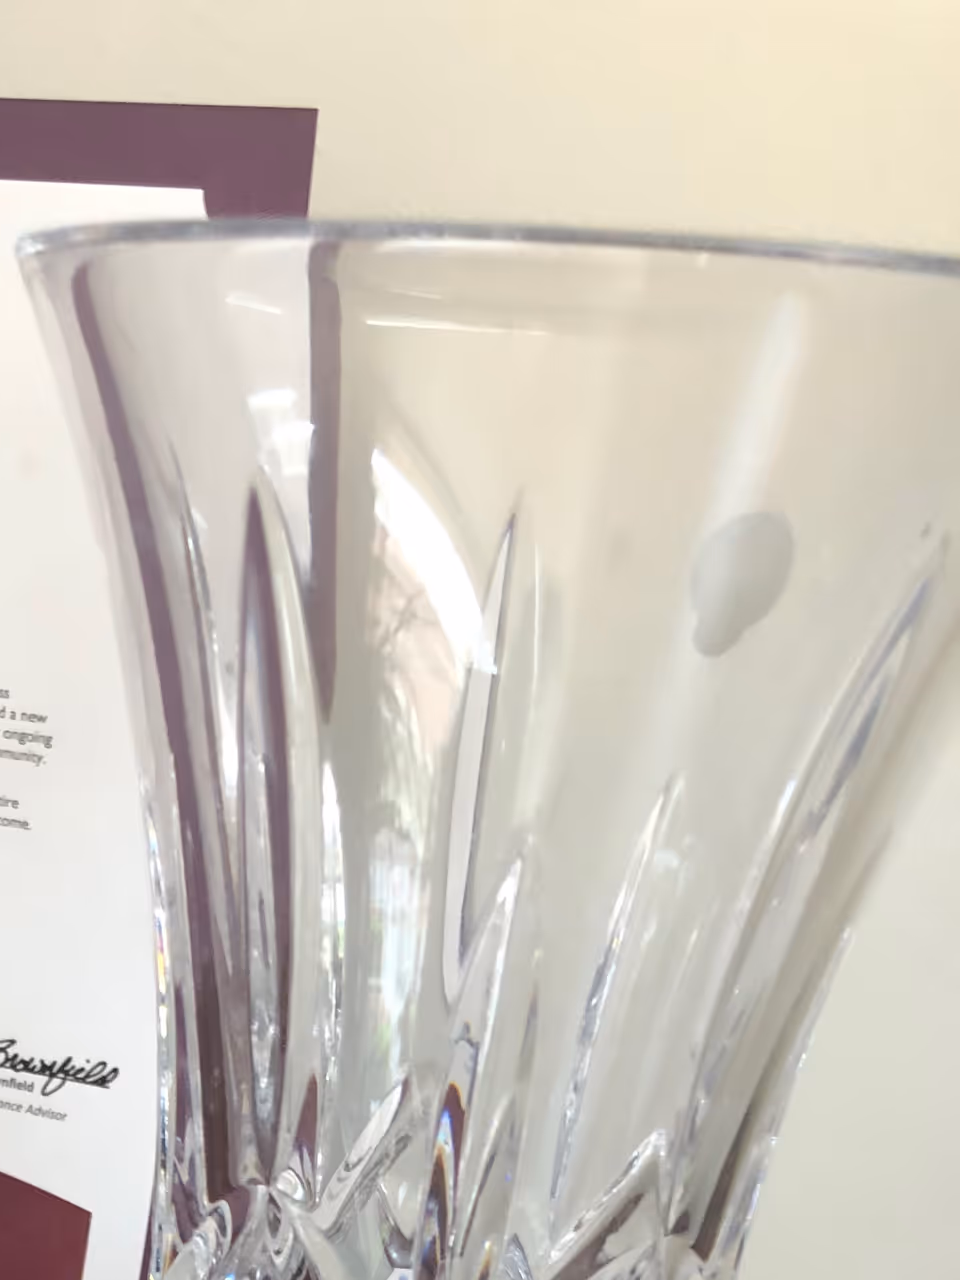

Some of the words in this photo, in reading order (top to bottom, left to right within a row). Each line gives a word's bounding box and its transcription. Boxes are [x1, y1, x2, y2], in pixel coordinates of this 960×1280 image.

[10, 711, 16, 720] a
[21, 712, 48, 723] new
[3, 728, 53, 749] ongoing
[25, 1103, 67, 1121] Advisor
